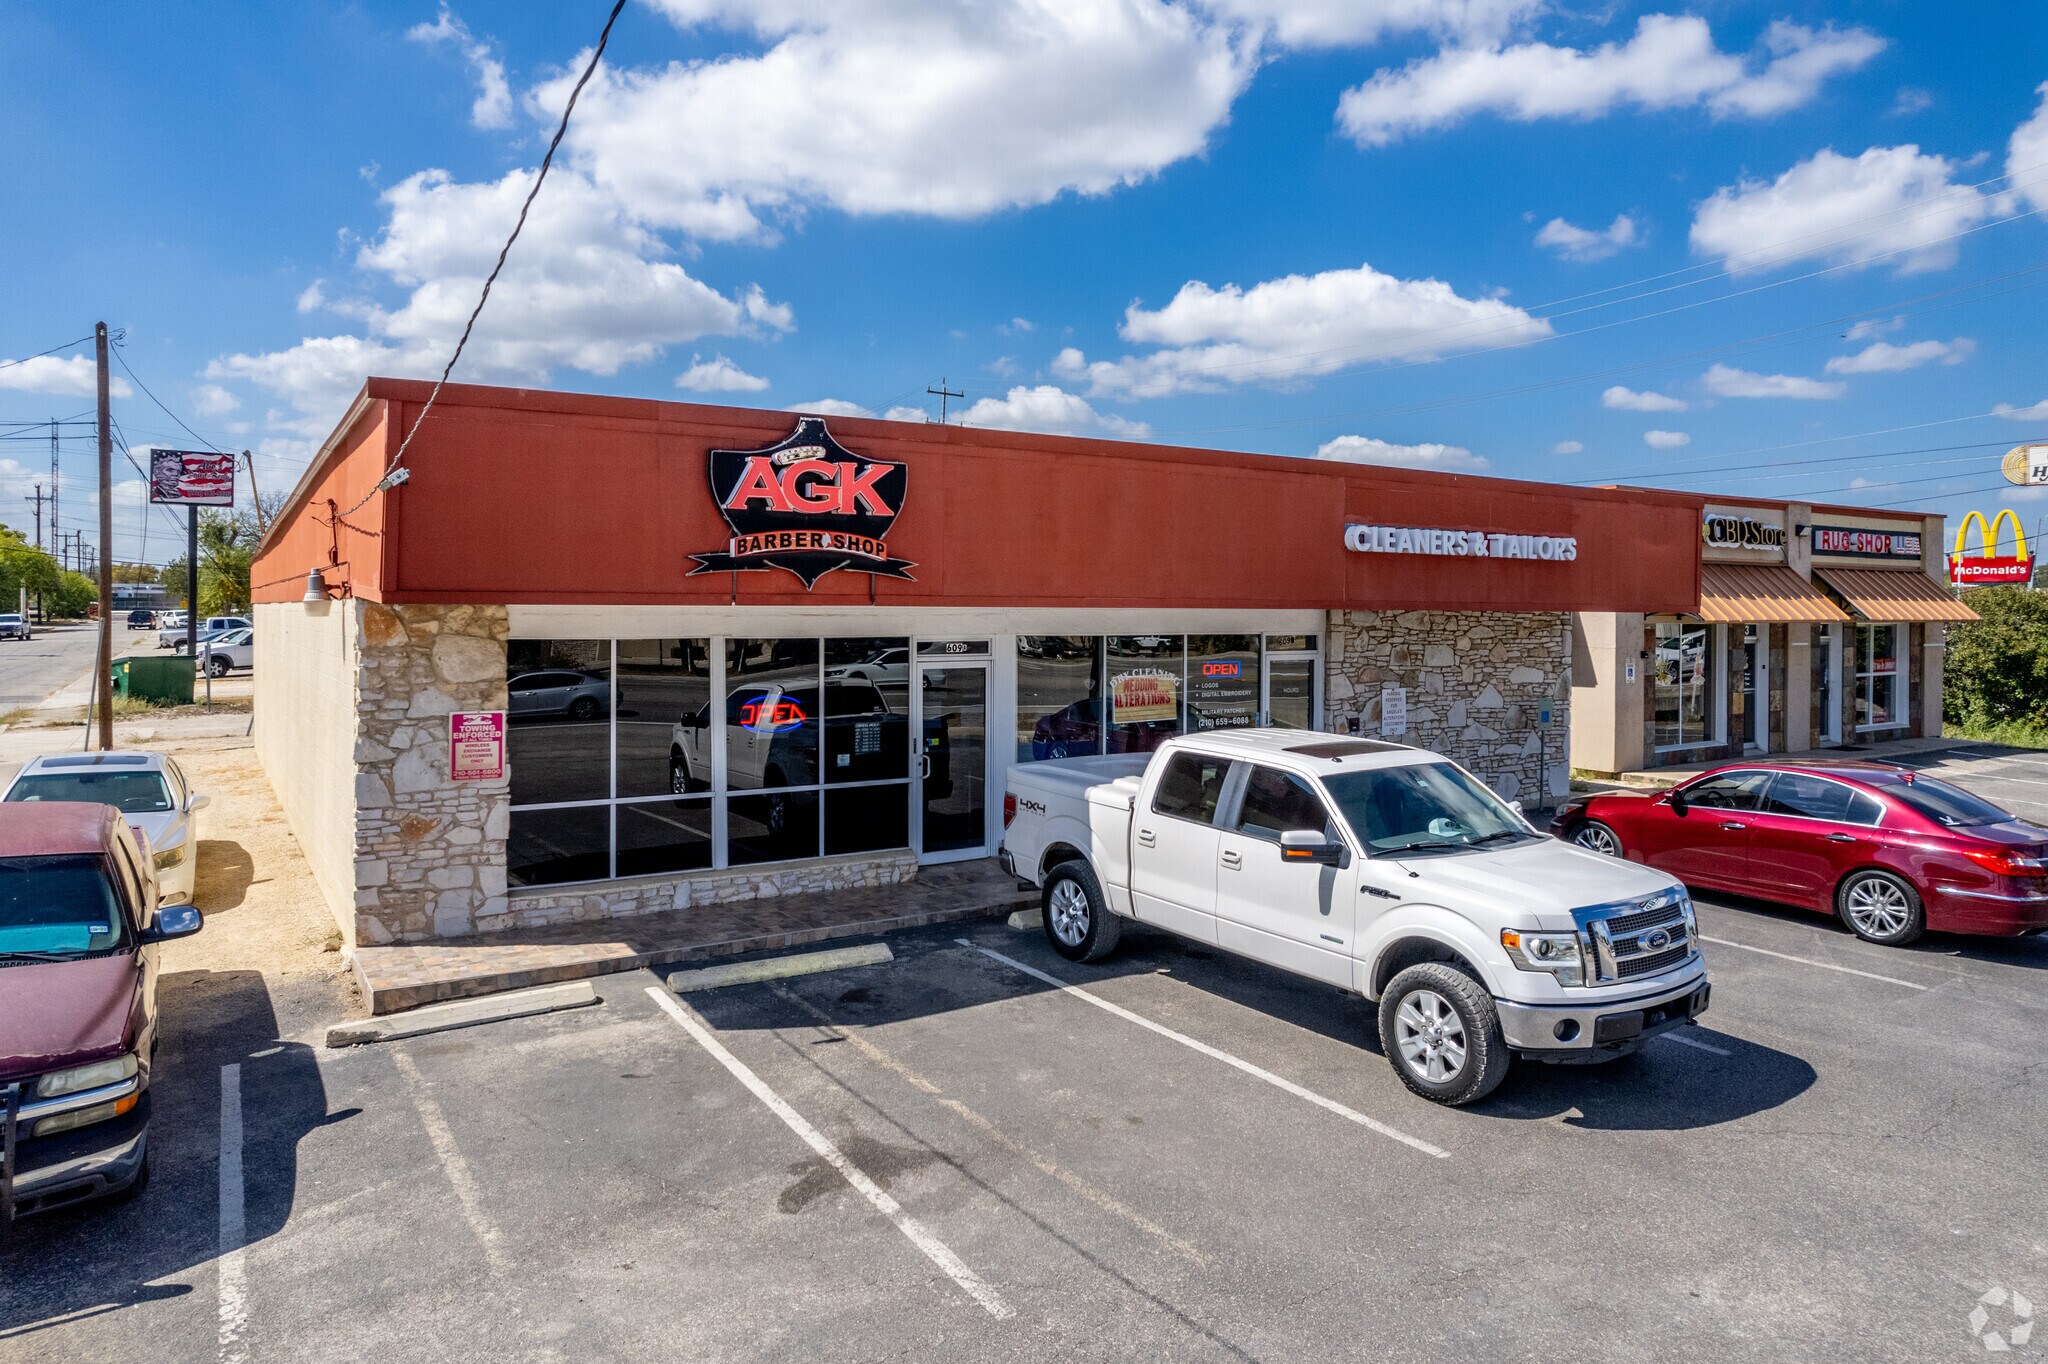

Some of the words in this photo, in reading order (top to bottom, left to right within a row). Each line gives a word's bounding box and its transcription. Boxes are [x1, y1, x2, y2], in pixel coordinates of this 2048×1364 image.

[2032, 466, 2048, 481] H
[723, 456, 895, 516] AGK
[1714, 518, 1748, 543] CBD
[1751, 520, 1788, 546] Store
[737, 532, 823, 555] BARBER
[833, 534, 885, 557] SHOP
[1346, 525, 1469, 556] CLEANERS
[1474, 532, 1489, 557] &
[1488, 533, 1577, 561] TAILORS
[1822, 530, 1850, 551] RUG
[1857, 532, 1892, 554] SHOP
[1954, 565, 2027, 576] McDonald's
[1109, 671, 1130, 688] DRY
[1132, 668, 1180, 687] CLEANING
[1203, 664, 1238, 675] OPEN
[1123, 678, 1158, 692] WEDDING
[739, 703, 807, 725] OPEN
[1198, 719, 1215, 728] (210)
[1215, 717, 1249, 726] 659-6088
[453, 731, 502, 739] ENFORCED
[459, 724, 496, 732] TOWING
